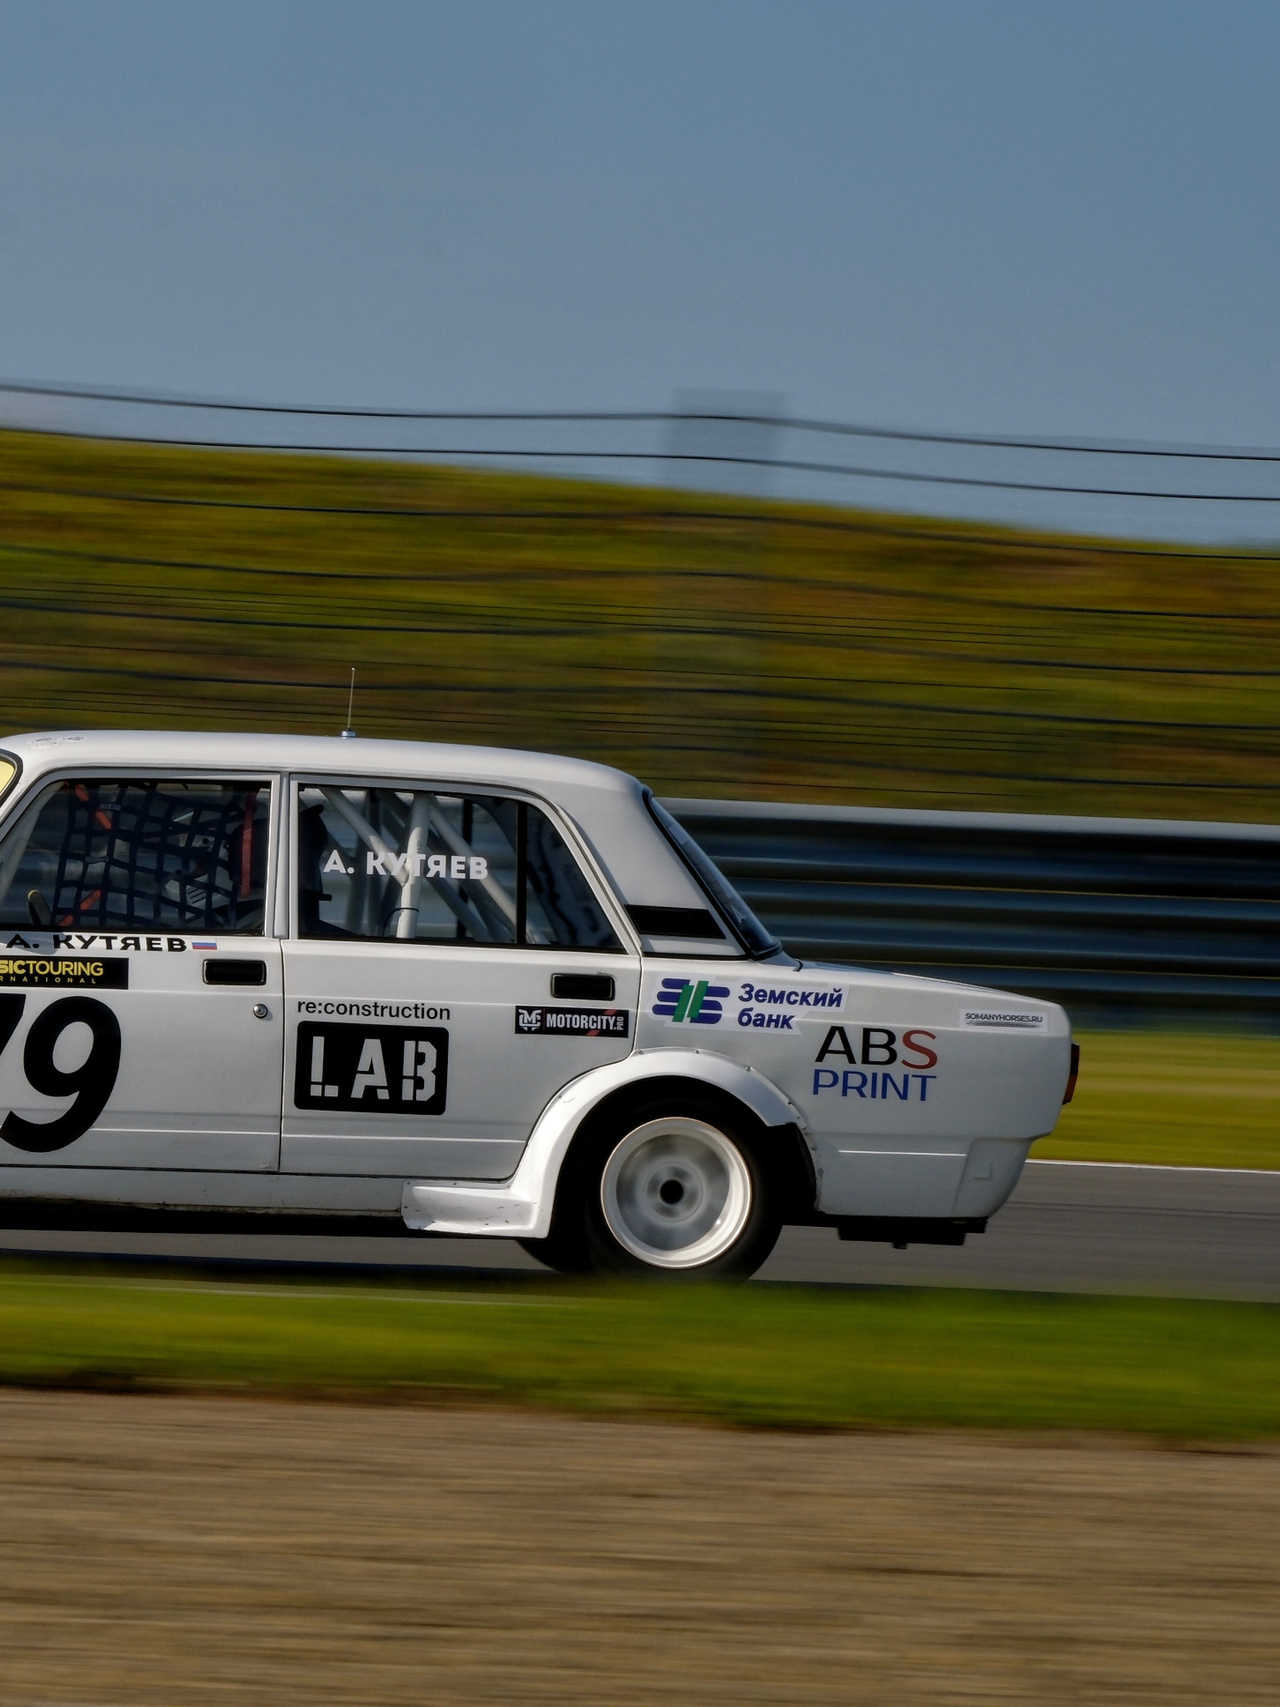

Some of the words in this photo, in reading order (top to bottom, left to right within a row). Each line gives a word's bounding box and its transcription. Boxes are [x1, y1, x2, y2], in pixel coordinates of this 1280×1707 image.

[323, 849, 355, 874] А.
[366, 851, 489, 880] КУТЯЕВ
[6, 934, 39, 949] А.
[53, 934, 187, 952] КУТЯЕВ
[738, 983, 843, 1008] Земский
[297, 1000, 451, 1020] re:construction
[738, 1007, 796, 1030] банк
[965, 1012, 1043, 1023] SOMANYHORSES.RU
[815, 1025, 938, 1069] ABS
[310, 1036, 437, 1101] LAB
[812, 1069, 937, 1101] PRINT
